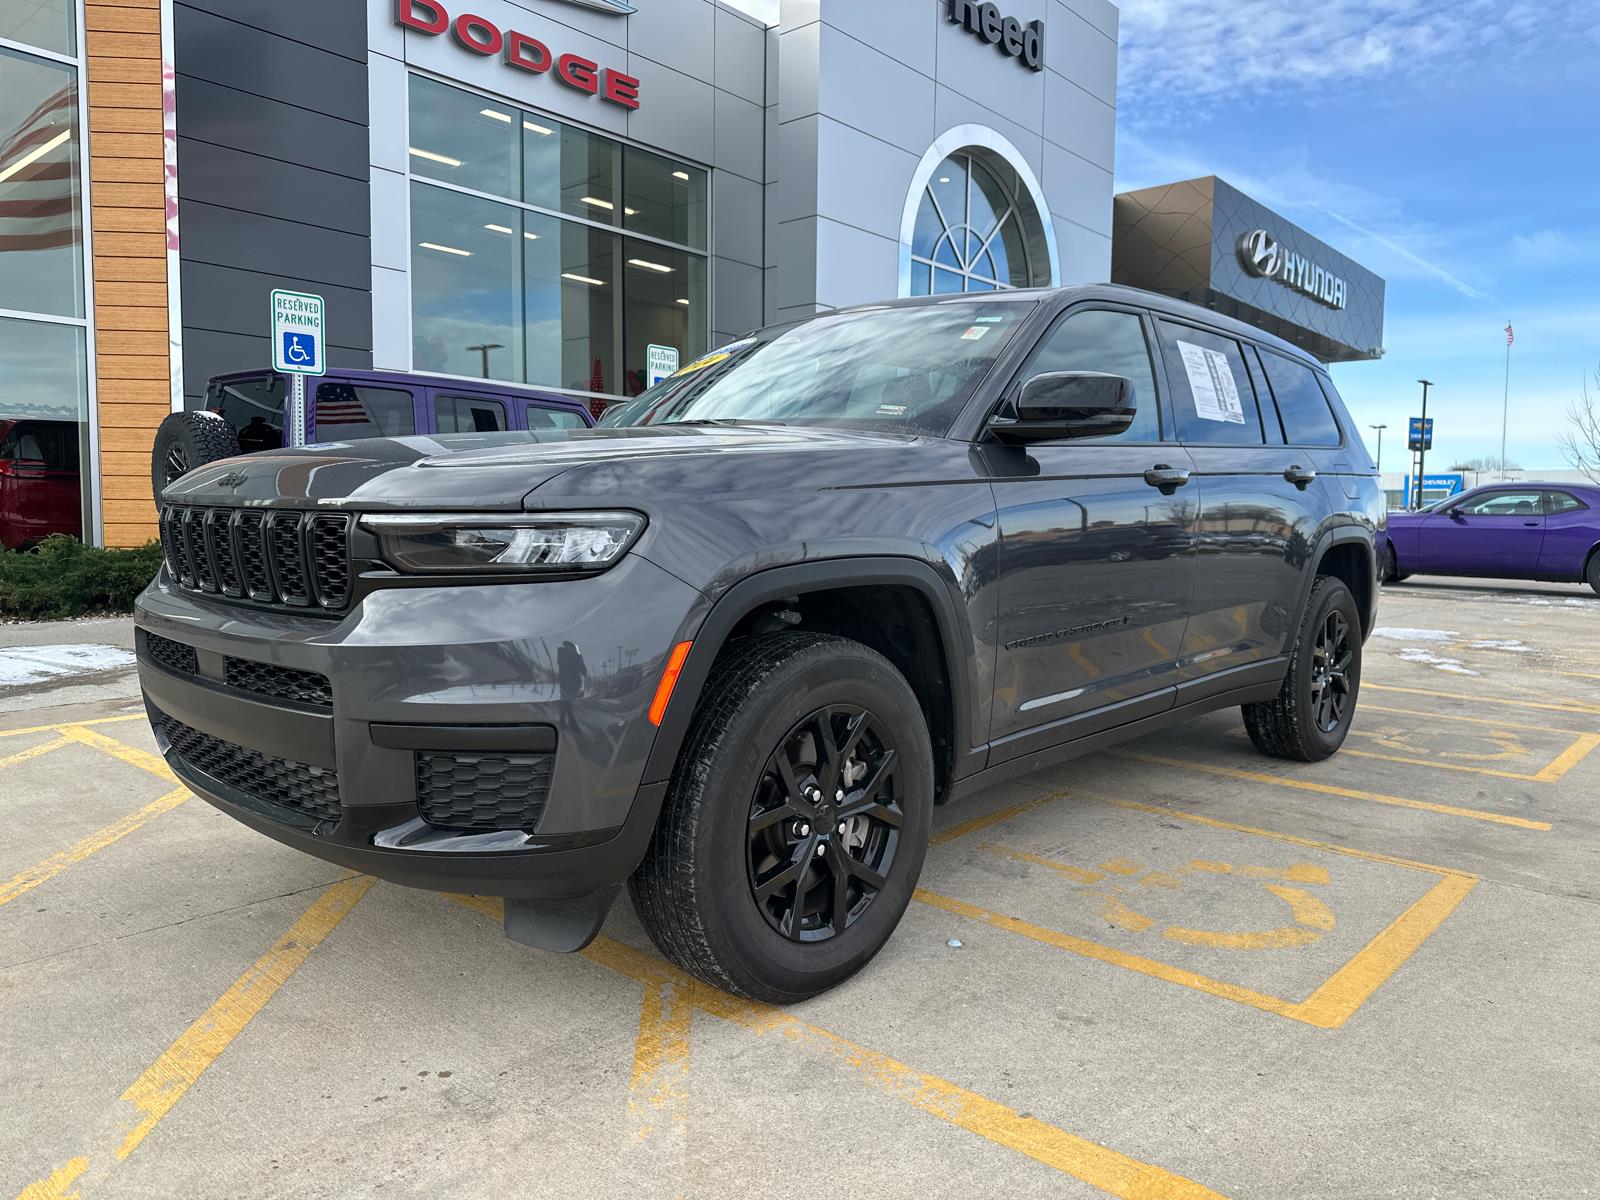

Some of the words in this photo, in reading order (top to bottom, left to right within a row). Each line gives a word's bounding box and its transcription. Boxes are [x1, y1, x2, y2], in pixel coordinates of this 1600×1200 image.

[395, 0, 640, 109] DODGE
[1283, 248, 1347, 309] HYUNDAI
[277, 298, 319, 314] RESERVED
[277, 312, 319, 328] PARKING
[650, 361, 676, 372] PARKING
